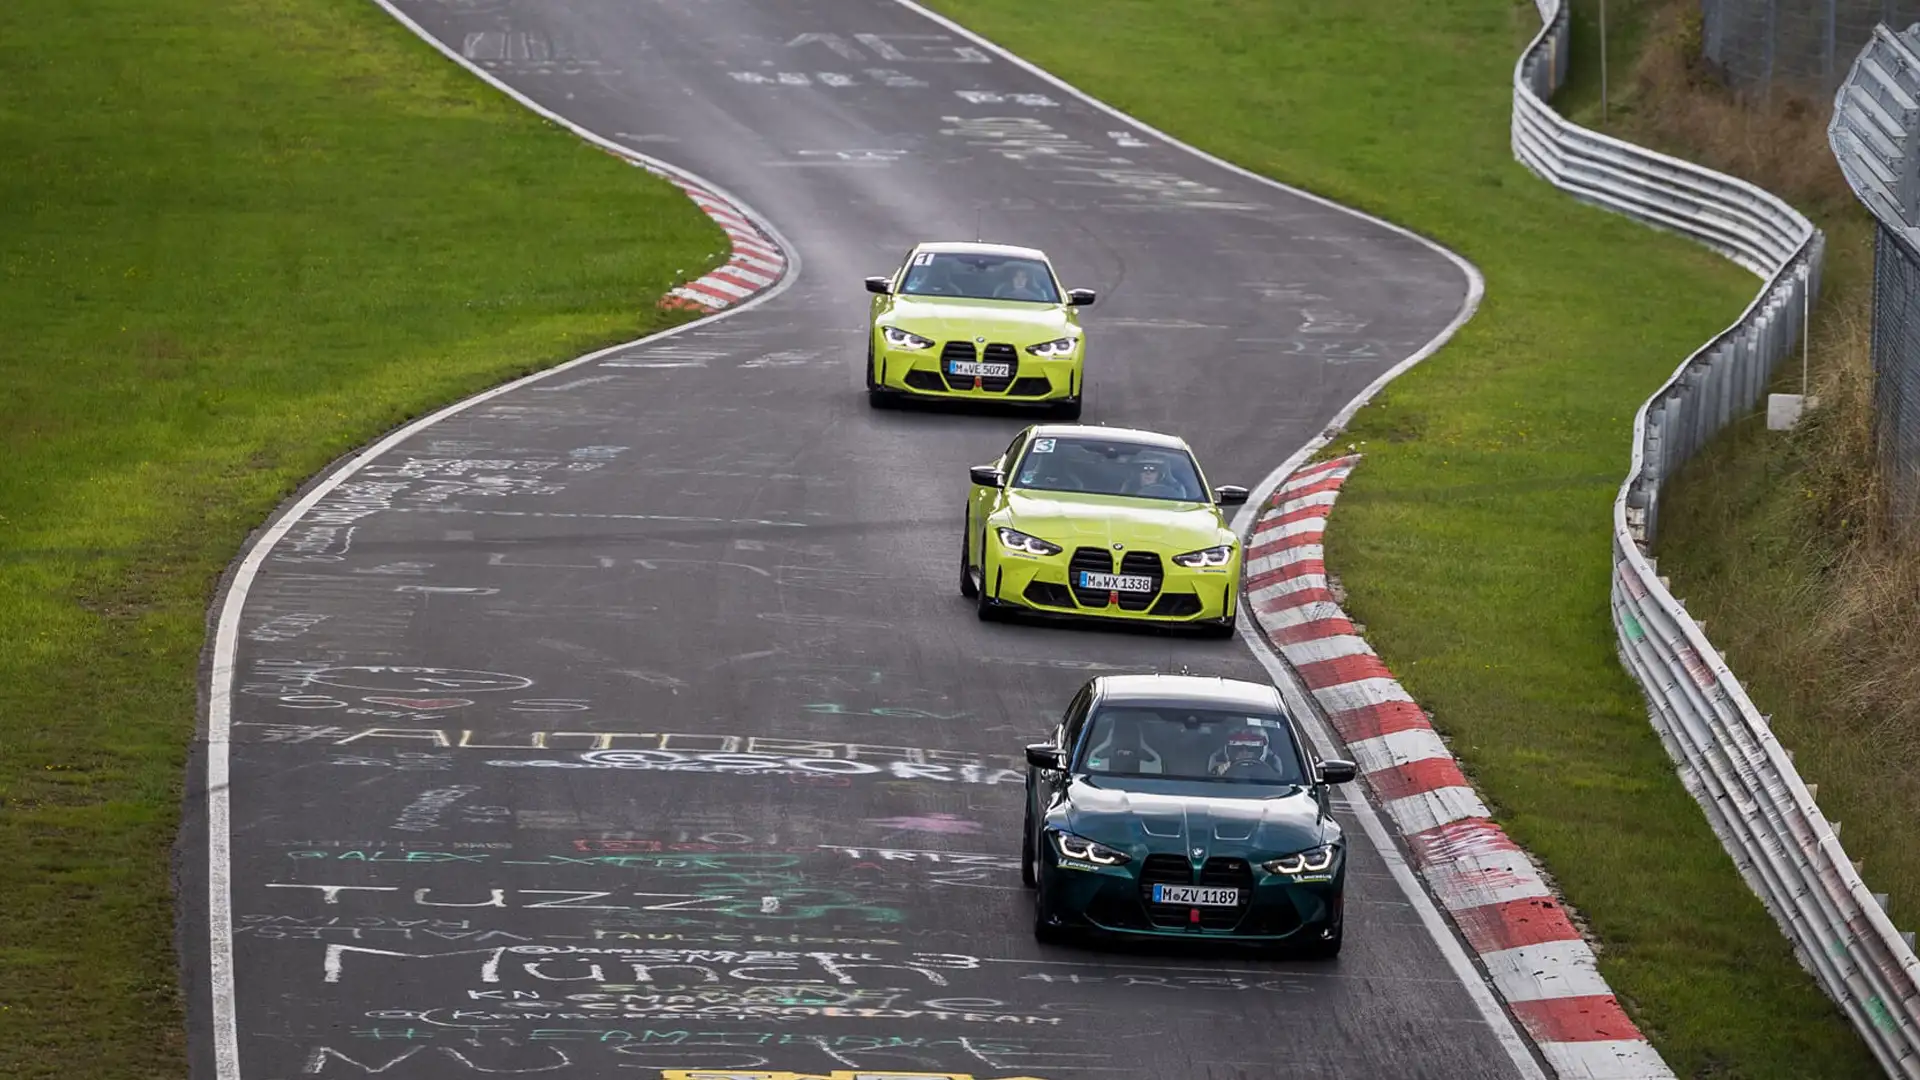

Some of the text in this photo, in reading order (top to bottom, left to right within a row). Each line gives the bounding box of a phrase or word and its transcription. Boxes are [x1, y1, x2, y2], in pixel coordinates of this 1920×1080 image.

[968, 364, 981, 373] VE
[983, 365, 1007, 375] 5072
[1036, 439, 1053, 451] 3
[1088, 574, 1150, 590] M WX 1338
[1162, 887, 1237, 904] M ZV 1189
